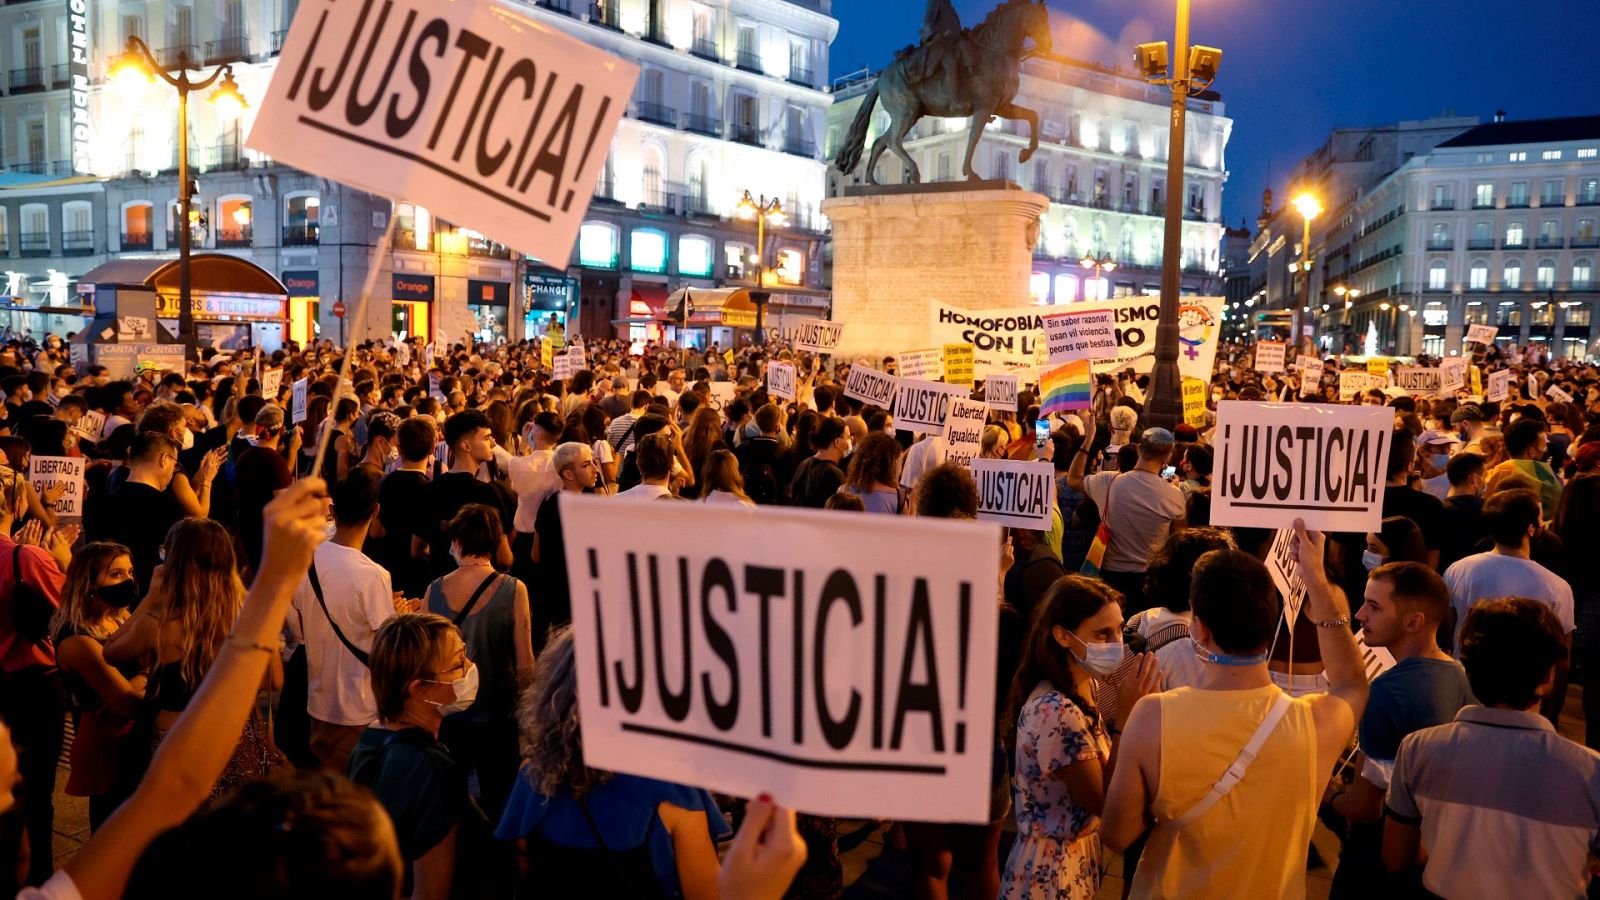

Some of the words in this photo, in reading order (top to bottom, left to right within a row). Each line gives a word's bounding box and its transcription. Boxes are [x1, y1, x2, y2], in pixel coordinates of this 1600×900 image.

[287, 0, 612, 213] ¡JUSTICIA!
[287, 277, 315, 291] Orange
[396, 280, 429, 293] Orange
[531, 284, 567, 296] CHANGE
[939, 308, 1044, 332] HOMOFOBIA
[1047, 317, 1060, 329] Sin
[1061, 315, 1080, 327] saber
[1081, 314, 1109, 325] razonar,
[1113, 304, 1160, 322] ISMO
[799, 323, 841, 347] ¡JUSTICIA!
[962, 329, 1013, 352] CON
[1049, 331, 1068, 341] usan
[1069, 328, 1078, 339] vil
[1079, 325, 1111, 338] violencia,
[1049, 343, 1074, 356] peores
[1075, 341, 1089, 353] que
[847, 369, 896, 401] ¡JUSTICIA!
[987, 379, 1017, 402] ¡JUSTICIA!
[34, 460, 73, 475] LIBERTAD
[74, 465, 80, 476] e
[1220, 424, 1385, 503] ¡JUSTICIA!
[975, 469, 1050, 515] JUSTICIA!
[587, 548, 973, 756] ¡JUSTICIA!
